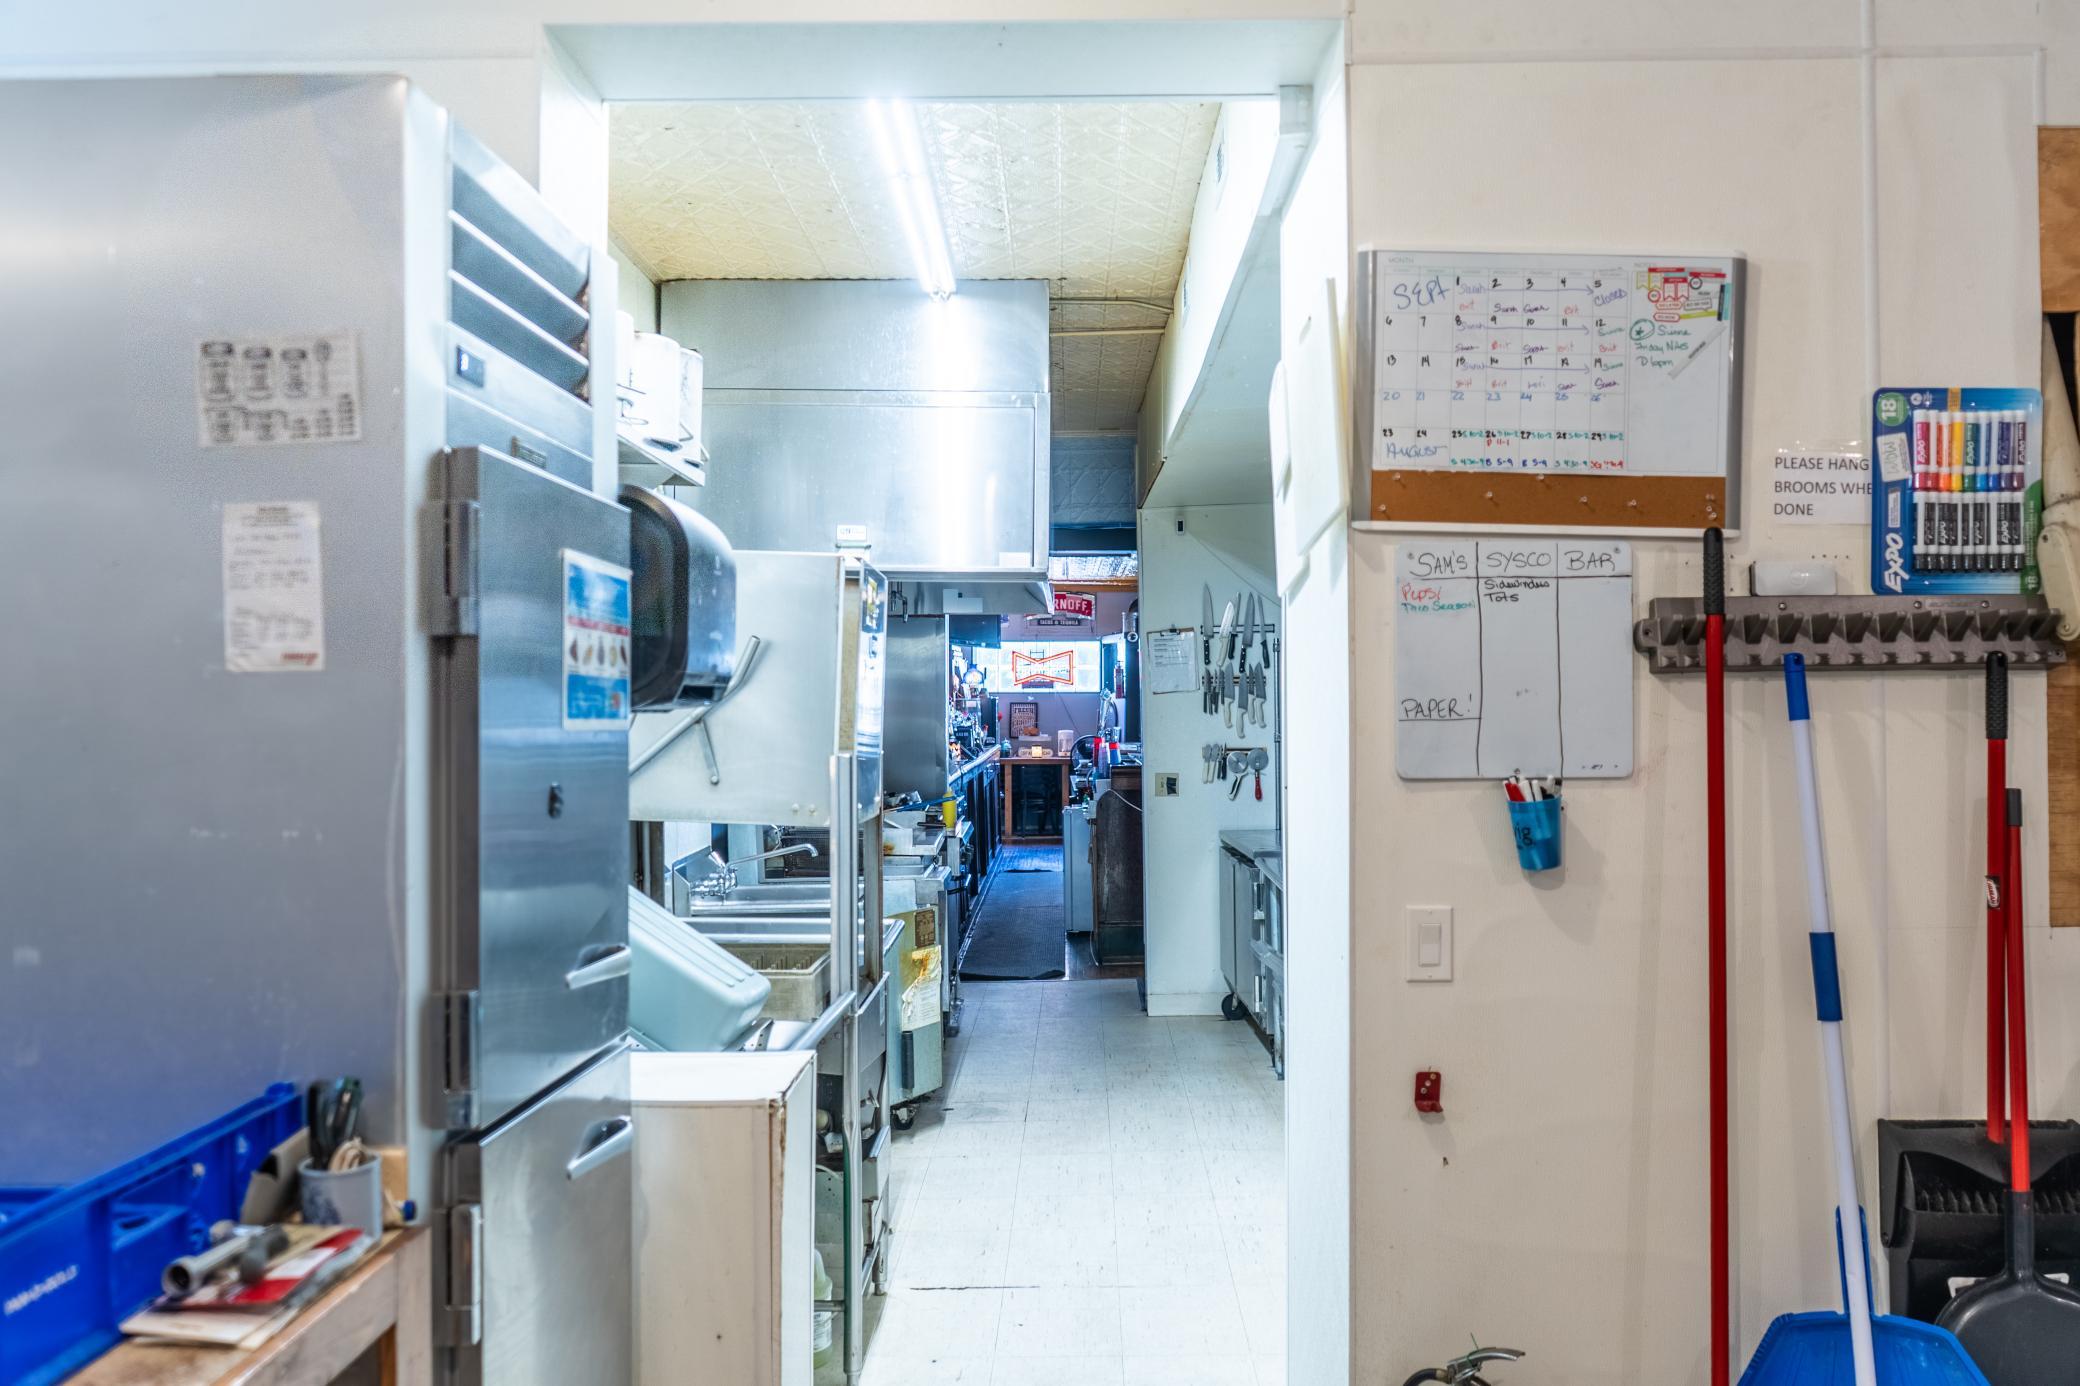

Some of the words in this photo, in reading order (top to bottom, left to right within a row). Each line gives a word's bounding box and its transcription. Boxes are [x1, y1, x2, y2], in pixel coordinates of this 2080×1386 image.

[1456, 276, 1460, 286] 1
[1492, 278, 1502, 288] 2
[1526, 278, 1534, 290] 3
[1561, 277, 1567, 288] 4
[1594, 280, 1602, 288] 5
[1386, 316, 1393, 326] 6
[1420, 316, 1427, 327] 7
[1455, 315, 1463, 326] 8
[1490, 315, 1497, 325] 9
[1527, 318, 1536, 327] 10
[1562, 318, 1568, 327] 11
[1595, 319, 1606, 327] 12
[1387, 354, 1397, 366] 13
[1421, 354, 1431, 367] 14
[1524, 355, 1533, 365] 17
[1594, 357, 1602, 368] 19
[1383, 391, 1401, 401] 20
[1416, 391, 1426, 401] 21
[1451, 391, 1465, 401] 22
[1487, 392, 1501, 401] 23
[1520, 392, 1533, 402] 24
[1881, 399, 1897, 421] 18
[1383, 428, 1394, 437] 23
[1417, 429, 1427, 438] 24
[1452, 430, 1462, 438] 25
[1485, 430, 1496, 438] 26
[1520, 430, 1531, 439] 27
[1556, 431, 1567, 440] 28
[1591, 432, 1602, 441] 29
[1917, 439, 1926, 463] EXPO
[1966, 441, 1975, 464] EXPO
[1775, 457, 1824, 470] PLEASE
[1828, 459, 1870, 471] HANG
[1774, 481, 1837, 495] BROOMS
[1773, 503, 1814, 516] DONE
[1939, 521, 1948, 544] EXPO
[2001, 520, 2011, 544] EXPO
[1409, 551, 1468, 577] SAM'S
[1486, 551, 1552, 572] SYSCO
[1564, 550, 1617, 571] BAR
[1884, 532, 1911, 593] EXPO
[1484, 591, 1520, 603] Tots
